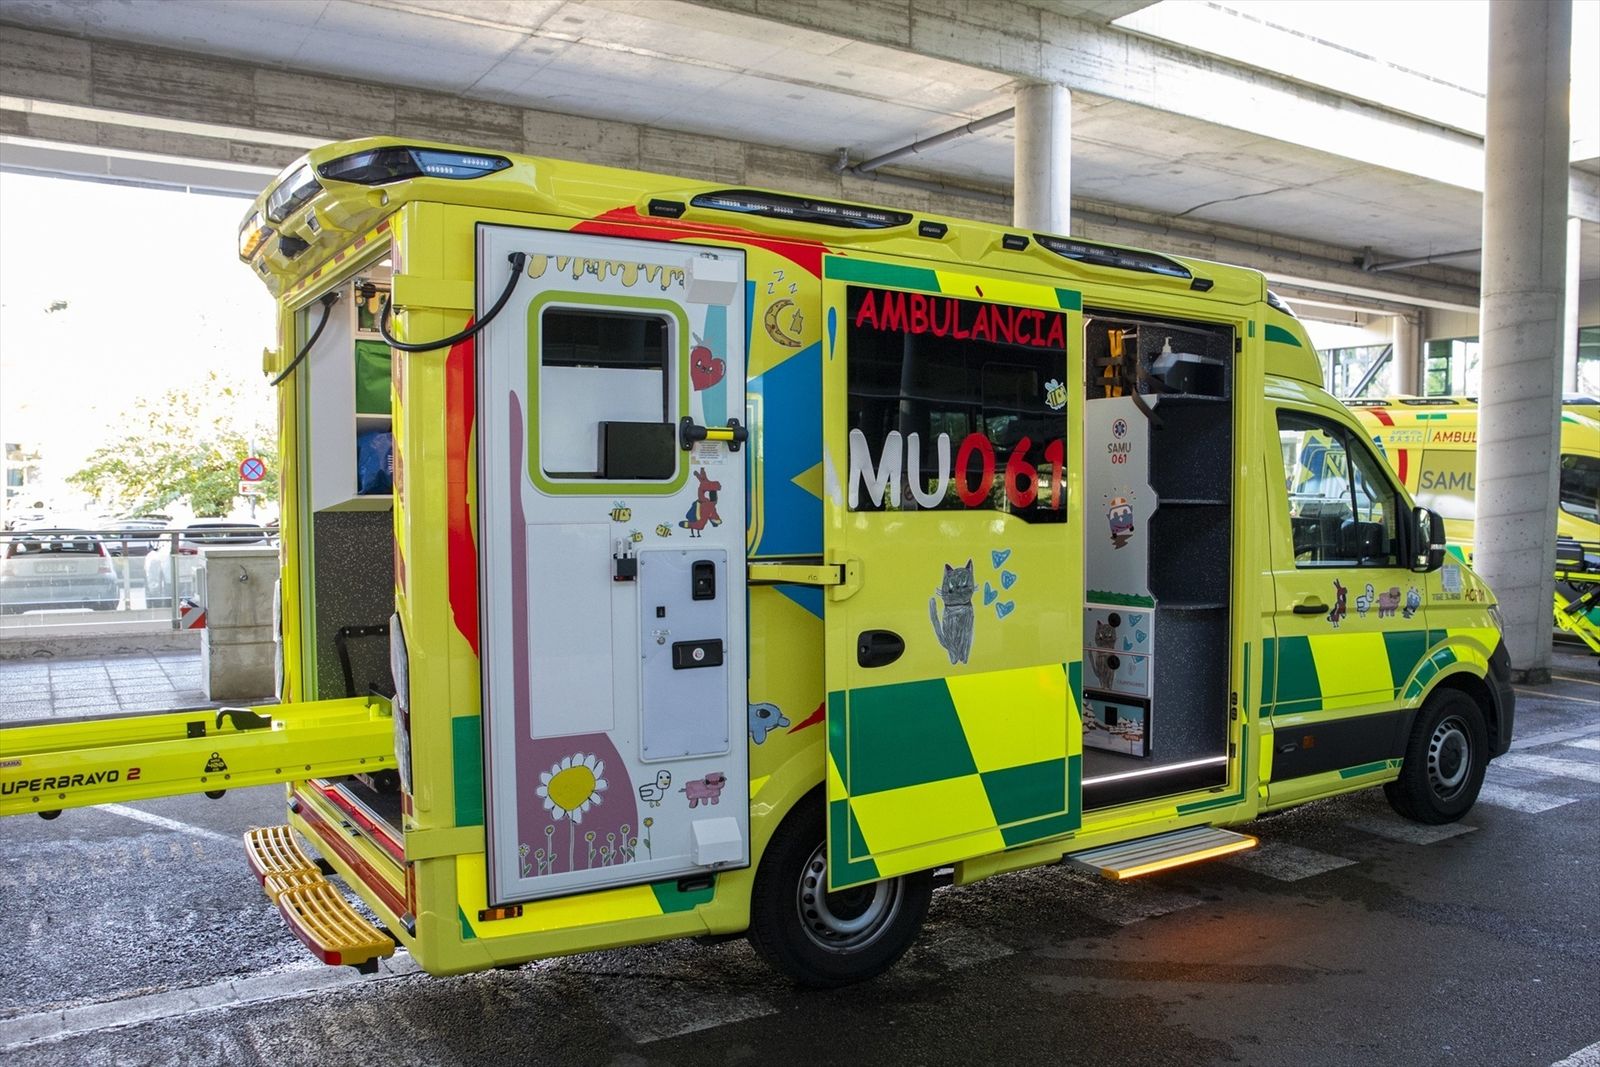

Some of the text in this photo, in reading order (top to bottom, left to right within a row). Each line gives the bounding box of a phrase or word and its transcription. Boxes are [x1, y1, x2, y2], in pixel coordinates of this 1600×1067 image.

[856, 290, 1065, 348] AMBULANCIA
[1432, 431, 1477, 443] AMBUL
[1107, 442, 1131, 453] SAMU
[1112, 453, 1127, 465] 061
[1, 767, 141, 795] UPERBRAVO 2
